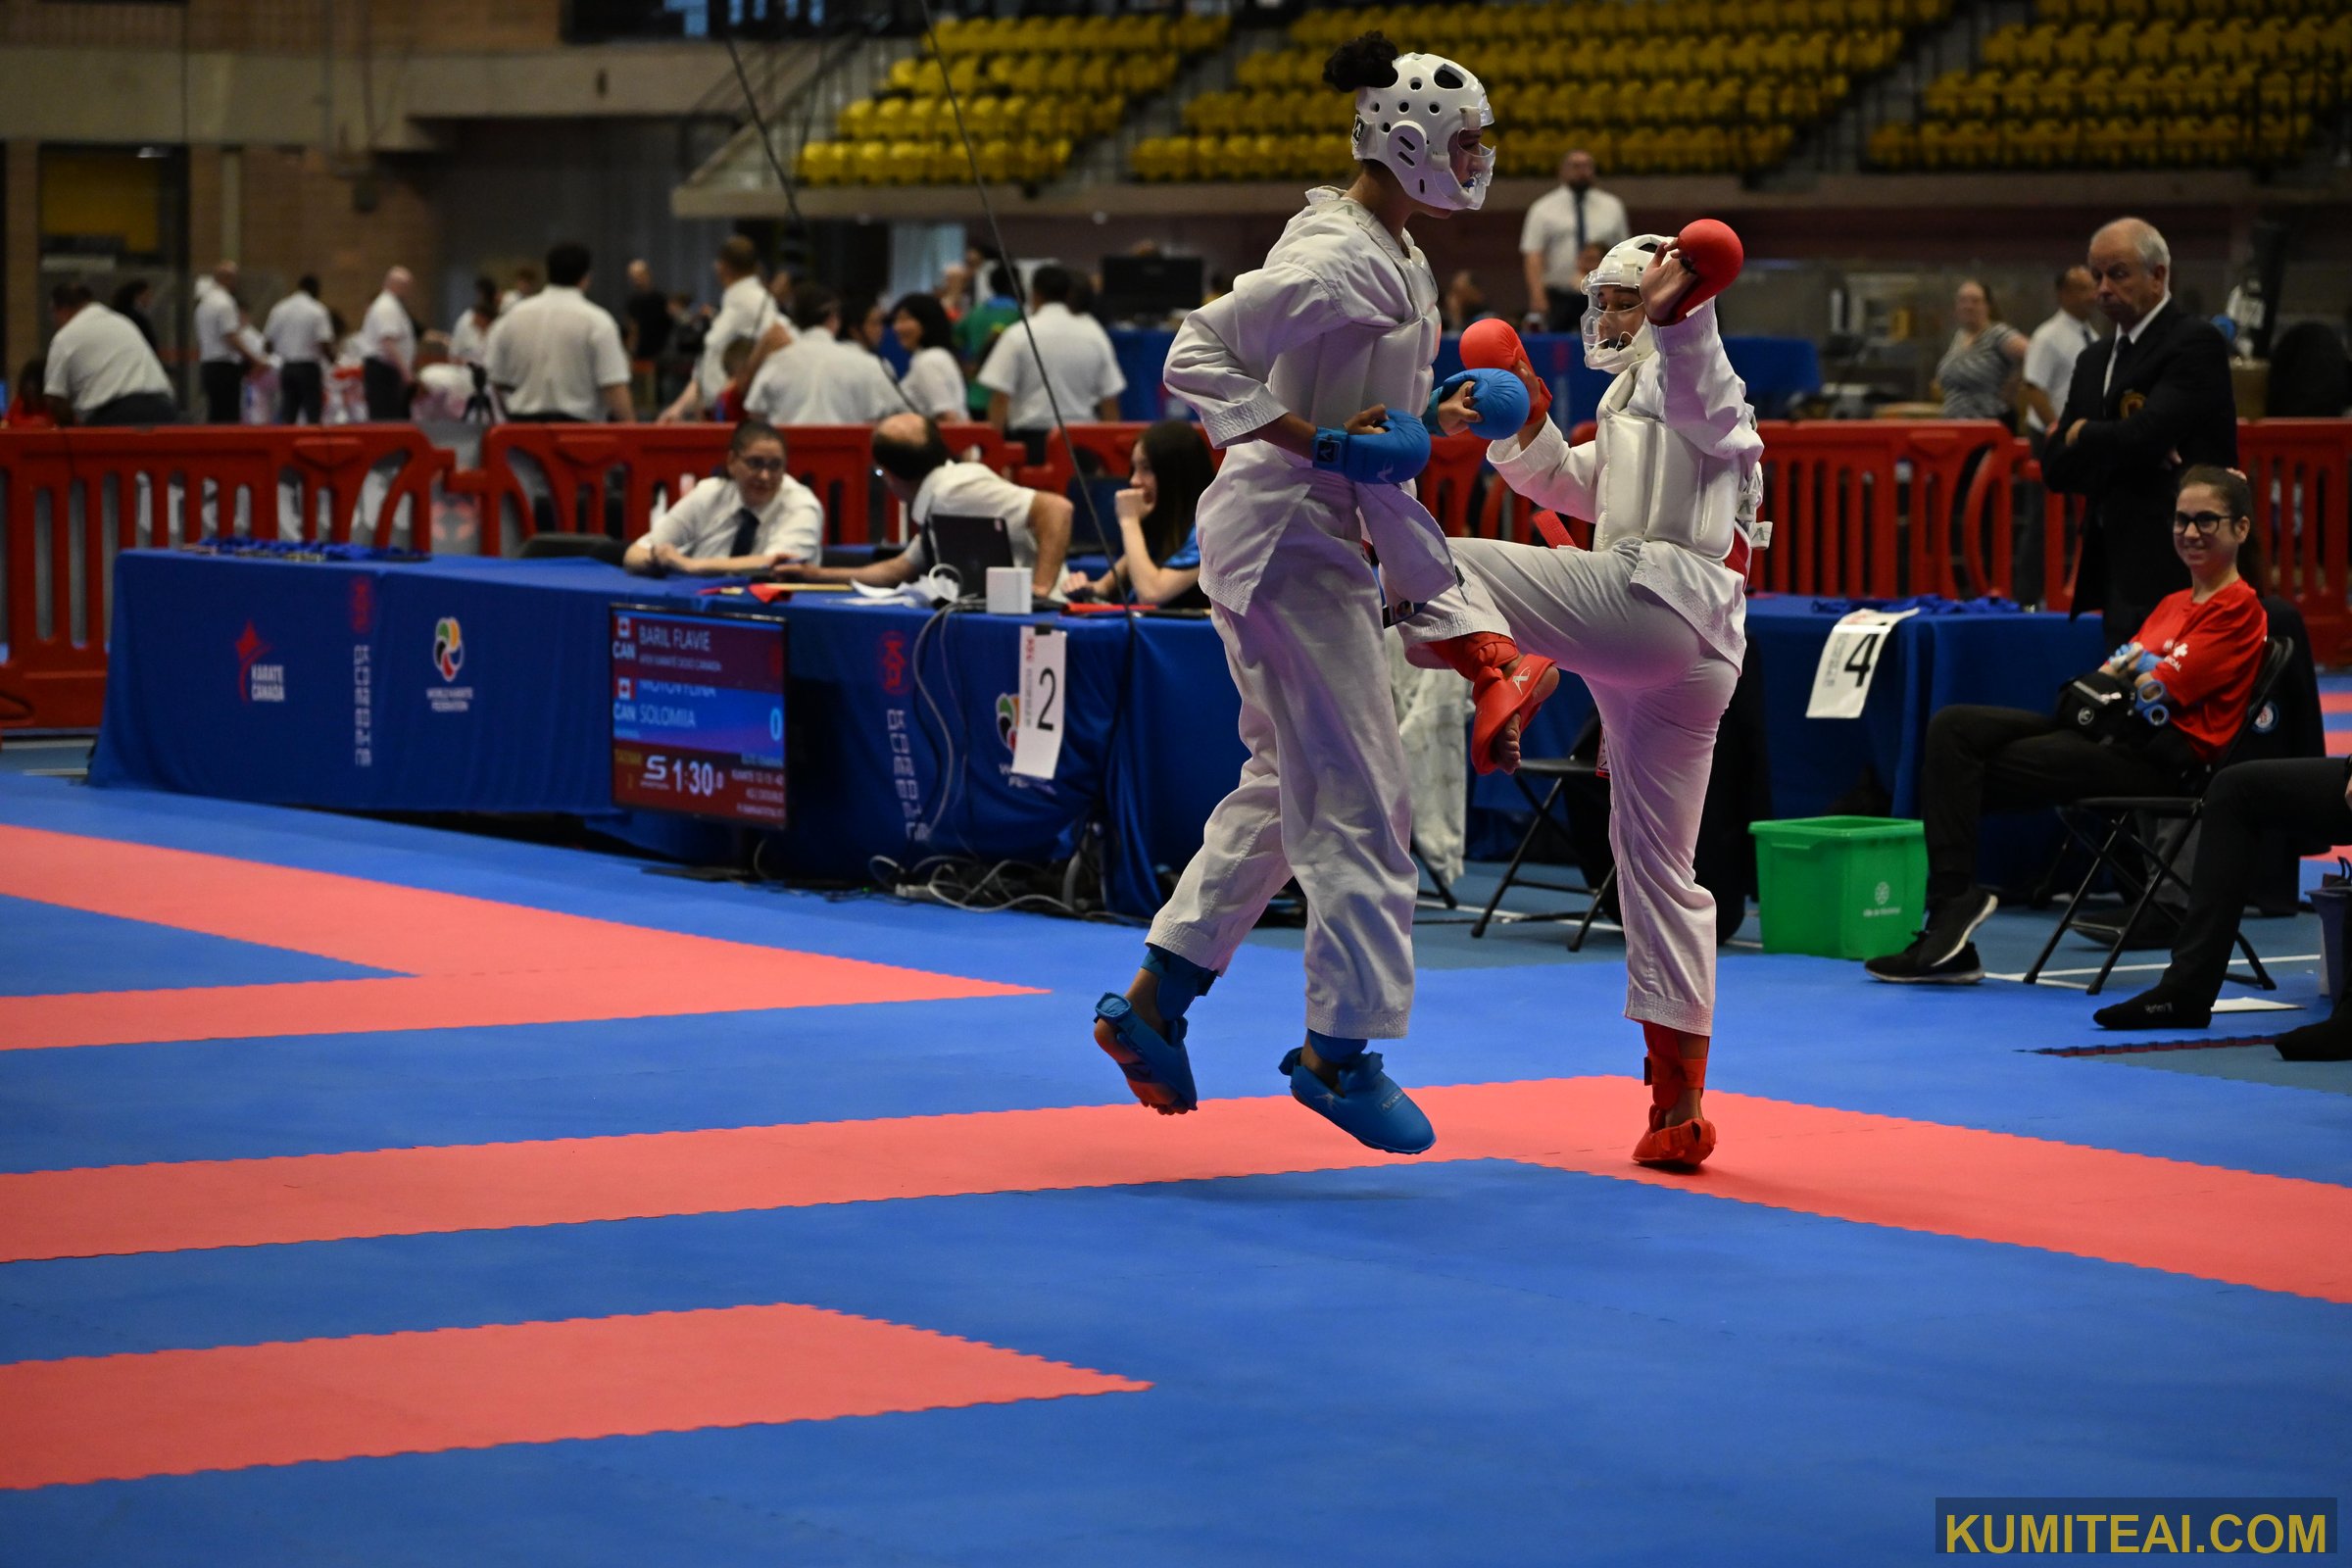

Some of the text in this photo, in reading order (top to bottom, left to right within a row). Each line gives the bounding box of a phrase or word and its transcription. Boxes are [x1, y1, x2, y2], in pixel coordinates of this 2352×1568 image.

[612, 641, 635, 659] CAN
[639, 624, 710, 652] BARIL FLAVIE
[1843, 621, 1887, 688] 4
[251, 683, 284, 702] CANADA
[1037, 667, 1056, 731] 2
[612, 702, 635, 721] CAN
[769, 707, 783, 742] 0
